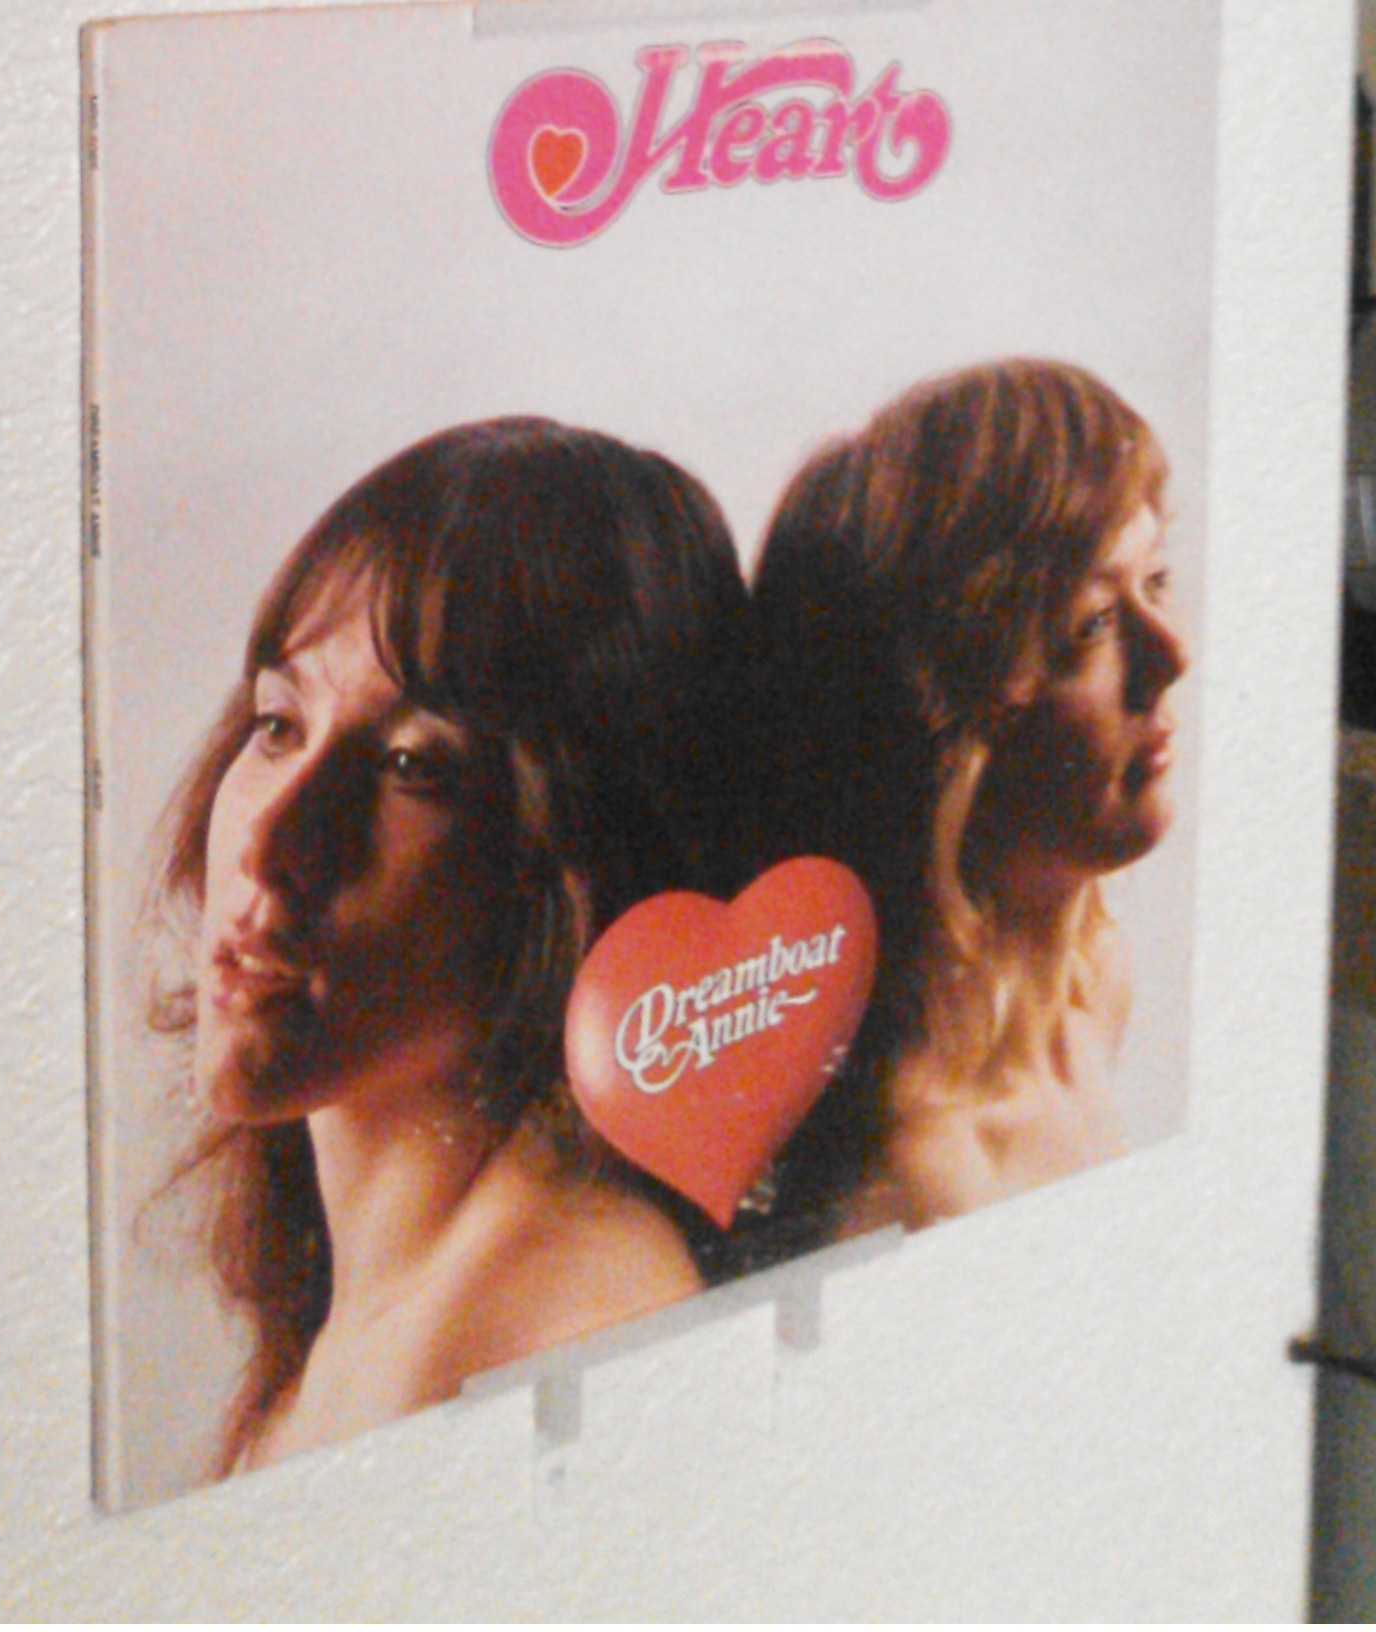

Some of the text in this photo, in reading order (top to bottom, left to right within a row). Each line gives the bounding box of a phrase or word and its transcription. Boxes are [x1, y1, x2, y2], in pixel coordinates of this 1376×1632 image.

[486, 36, 952, 249] Heart
[614, 923, 846, 1072] Dreamboat
[632, 986, 819, 1094] Annie
